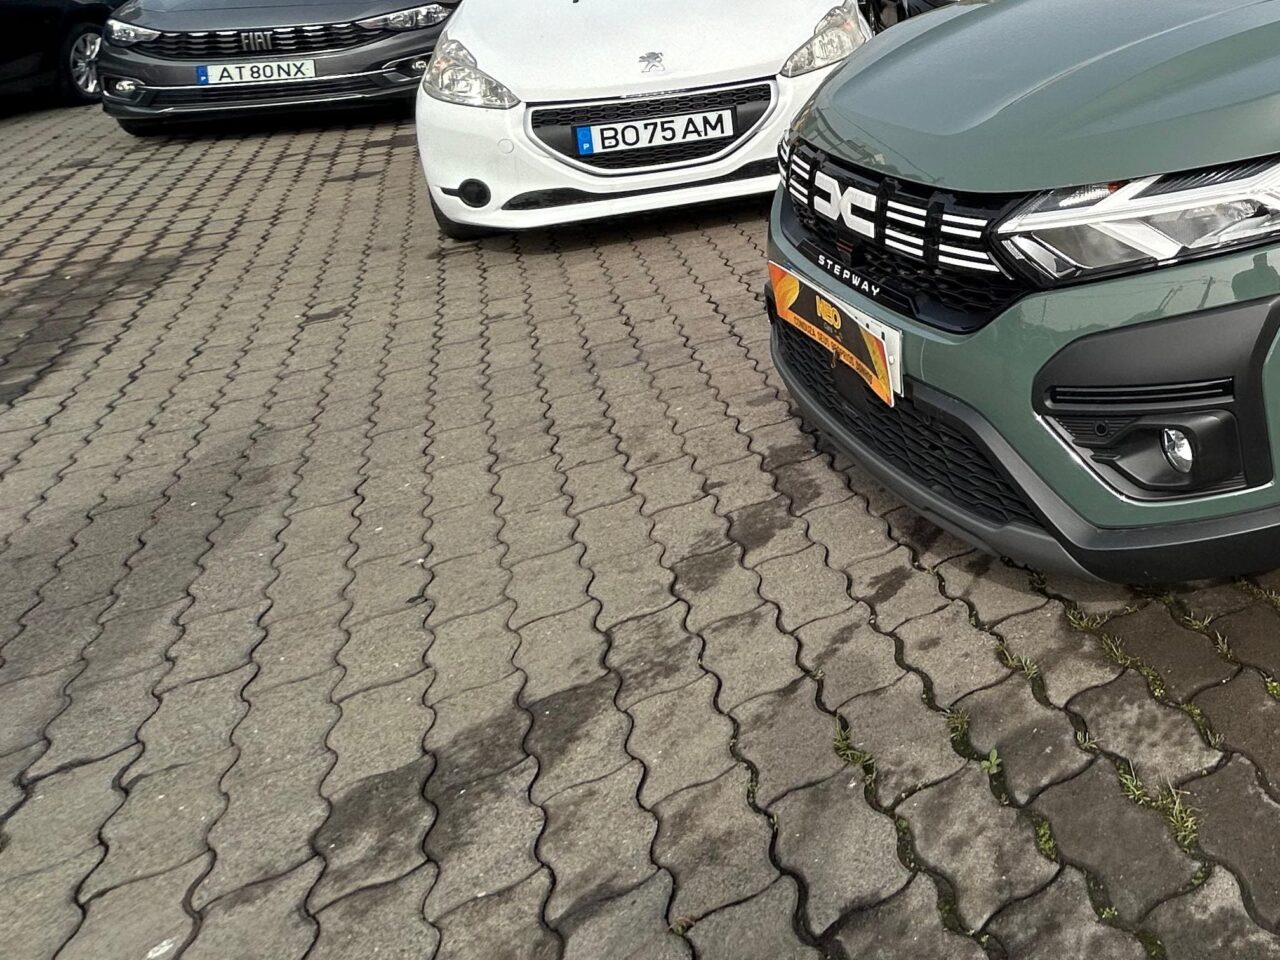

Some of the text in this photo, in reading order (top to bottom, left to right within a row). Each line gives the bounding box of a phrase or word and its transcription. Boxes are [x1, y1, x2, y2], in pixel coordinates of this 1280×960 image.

[240, 31, 273, 51] FIAT
[818, 254, 880, 296] STEPWAY
[815, 294, 842, 330] NEO
